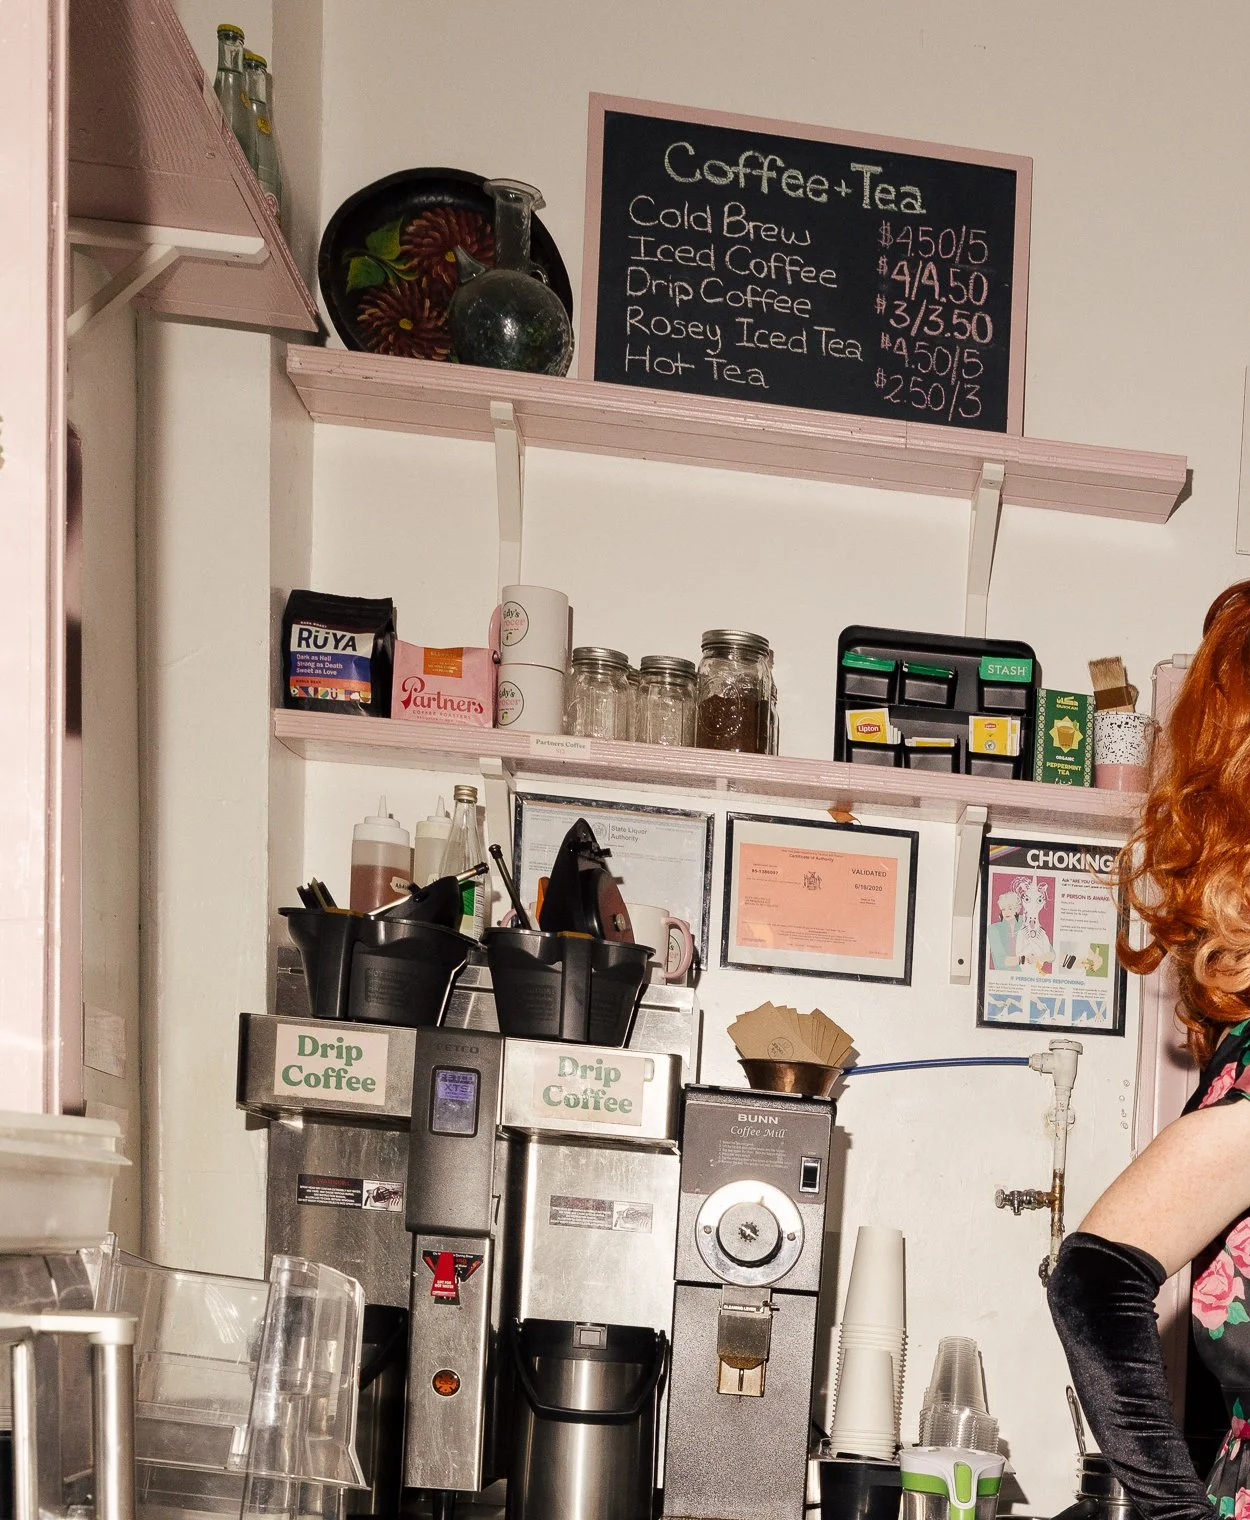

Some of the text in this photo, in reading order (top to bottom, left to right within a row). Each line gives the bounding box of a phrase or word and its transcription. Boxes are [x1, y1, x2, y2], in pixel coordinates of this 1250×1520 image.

[629, 195, 811, 245] Cold Brew
[629, 235, 838, 288] Iced Coffee
[626, 266, 812, 318] Drip Coffee
[877, 256, 989, 306] $4/4.50
[626, 305, 864, 362] Rosey Iced Tea
[875, 294, 994, 344] $3/3.50
[625, 343, 770, 389] Hot Tea
[297, 627, 357, 652] RÜYA
[987, 664, 1026, 676] STASH
[400, 675, 484, 715] Partners
[857, 724, 880, 733] Lipton
[535, 738, 586, 749] Partners Coffee
[1046, 761, 1082, 772] PEPPERMINT
[610, 834, 639, 842] Authority
[611, 825, 626, 834] State
[628, 828, 647, 836] Liquor
[851, 868, 887, 878] VALIDATED
[1026, 849, 1114, 872] CHOKING
[297, 1035, 363, 1066] Drip
[281, 1064, 376, 1093] Coffee
[557, 1055, 621, 1087] Drip
[542, 1085, 633, 1114] Coffee
[730, 1125, 788, 1138] Coffee Mill
[737, 1113, 779, 1124] BUNN
